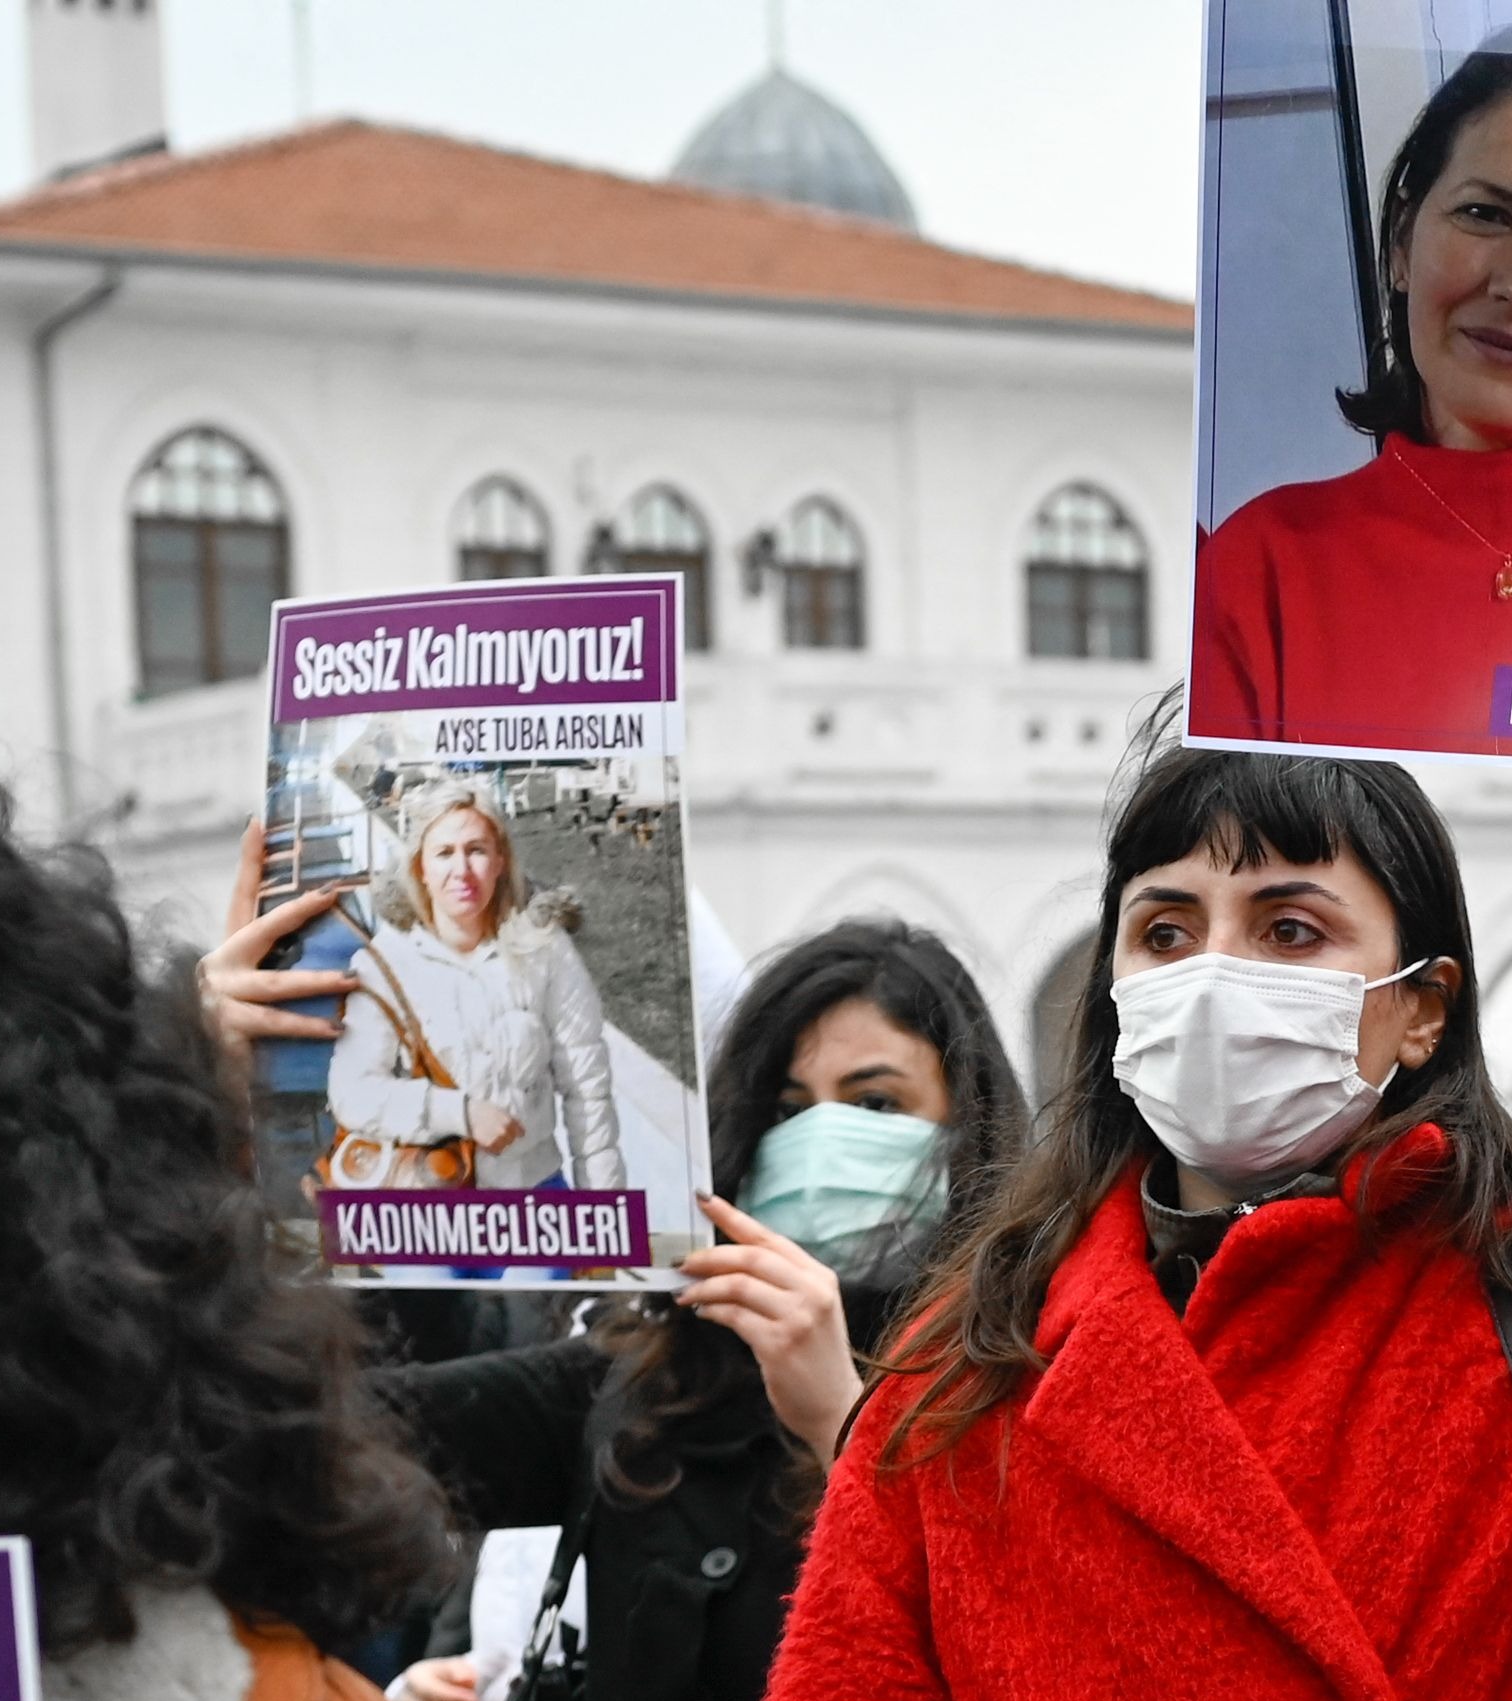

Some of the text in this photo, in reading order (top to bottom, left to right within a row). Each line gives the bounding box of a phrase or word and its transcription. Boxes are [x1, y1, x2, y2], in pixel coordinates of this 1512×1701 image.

[292, 616, 645, 701] Sessiz Kalmıyoruz!
[435, 713, 645, 757] AYŞE TUBA ARSLAN
[336, 1194, 631, 1257] KADINMECLİSLERİ
